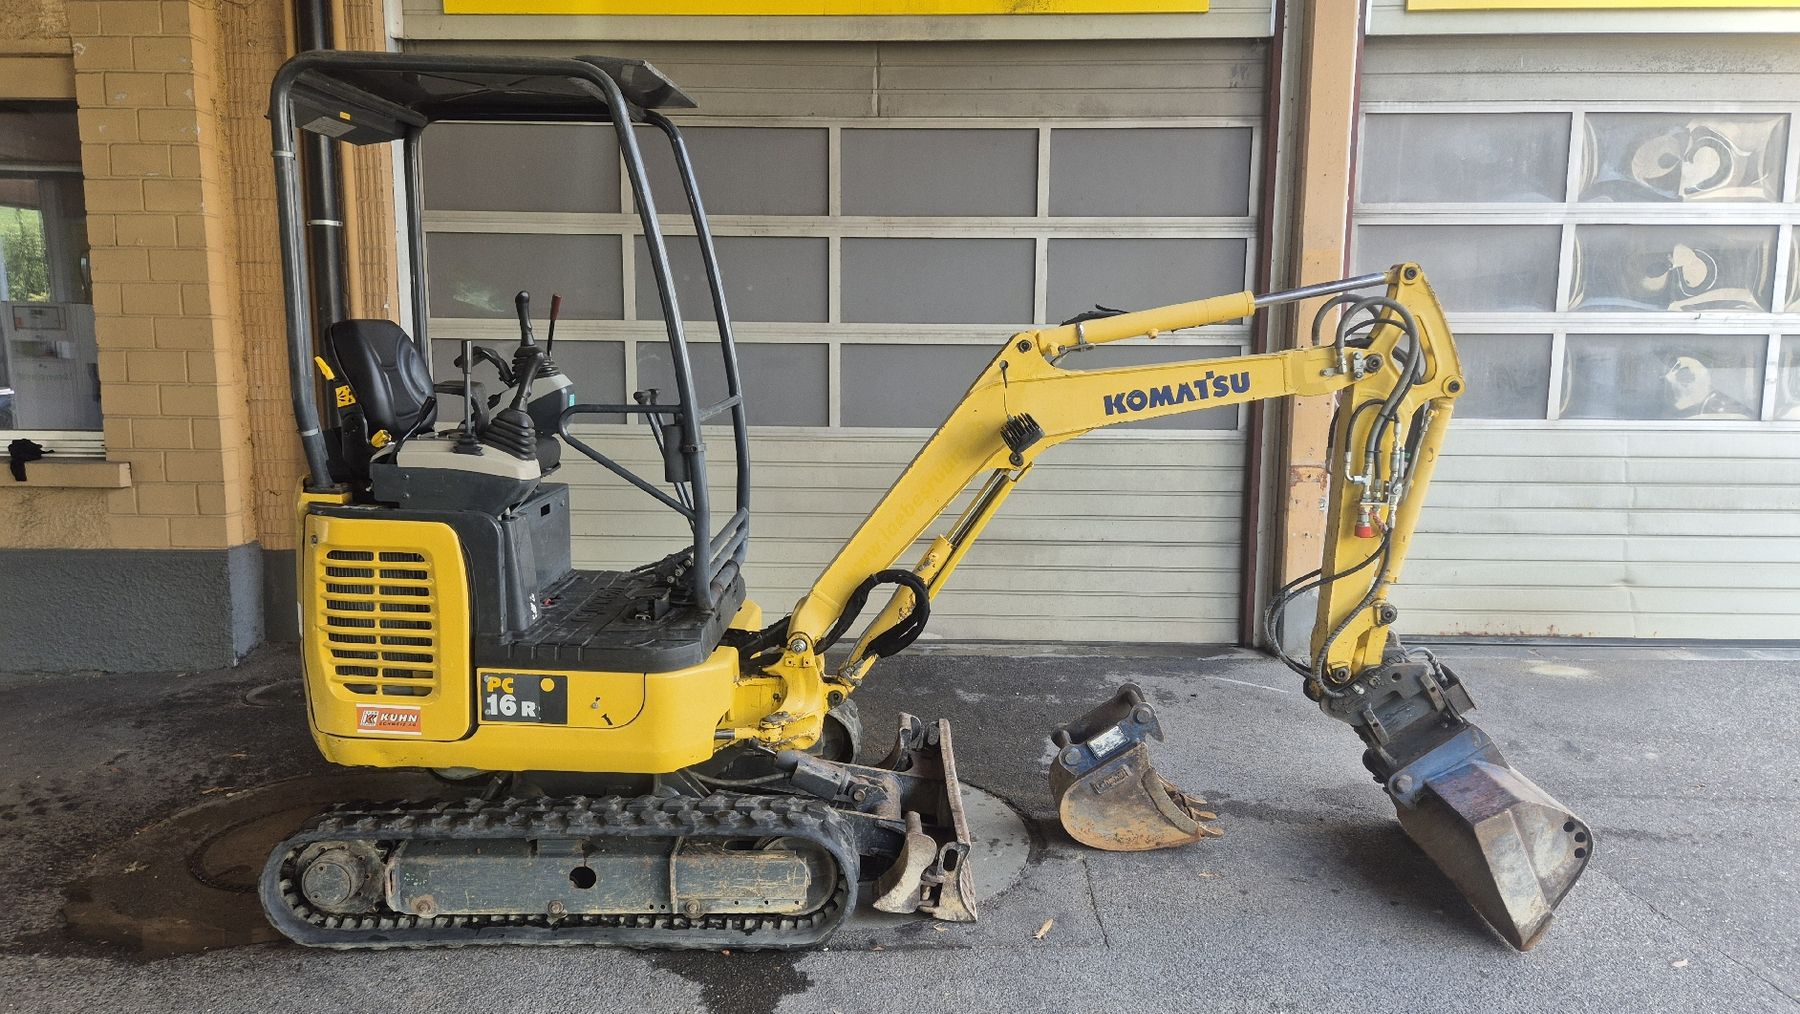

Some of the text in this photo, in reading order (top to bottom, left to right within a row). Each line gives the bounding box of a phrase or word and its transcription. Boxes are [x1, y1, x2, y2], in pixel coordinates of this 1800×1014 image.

[1104, 370, 1250, 416] KOMATSU
[487, 676, 514, 694] PC
[486, 693, 536, 717] 16 R
[380, 713, 418, 722] KUHN
